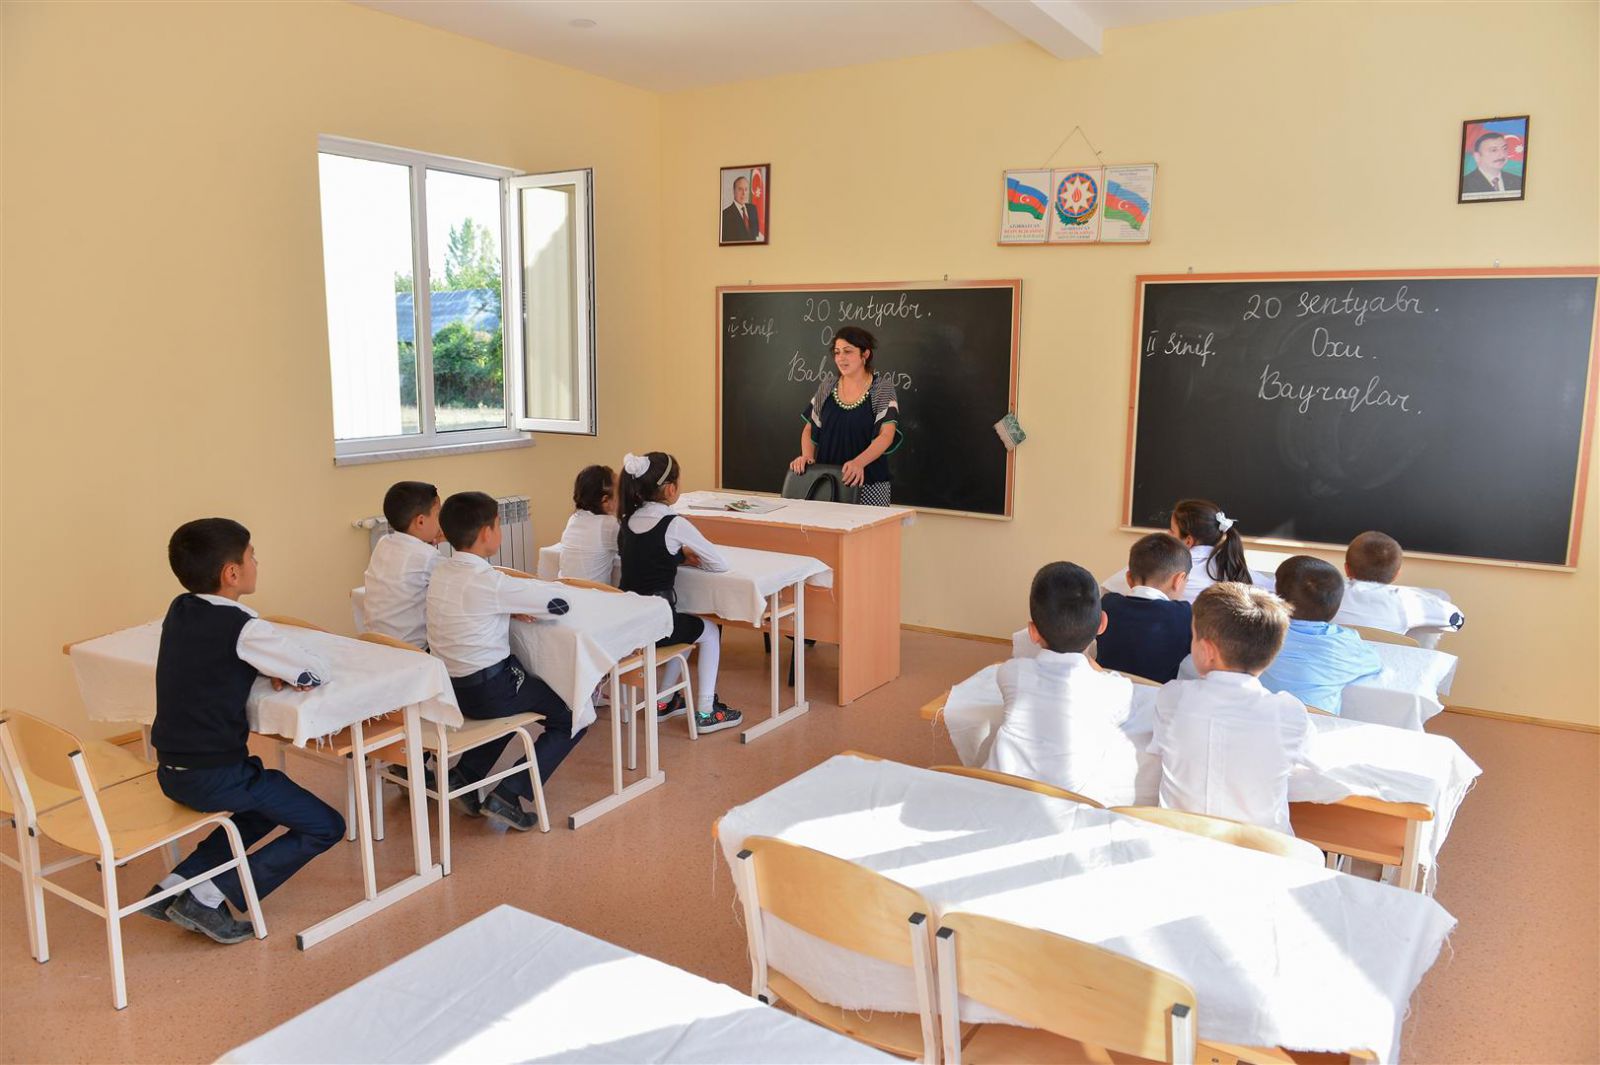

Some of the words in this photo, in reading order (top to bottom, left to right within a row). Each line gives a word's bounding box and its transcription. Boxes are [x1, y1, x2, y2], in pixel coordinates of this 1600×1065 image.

[803, 297, 831, 322] 20
[1243, 294, 1282, 321] 20
[1311, 326, 1377, 360] Oxu.
[1258, 364, 1422, 415] Bayraqlar.
